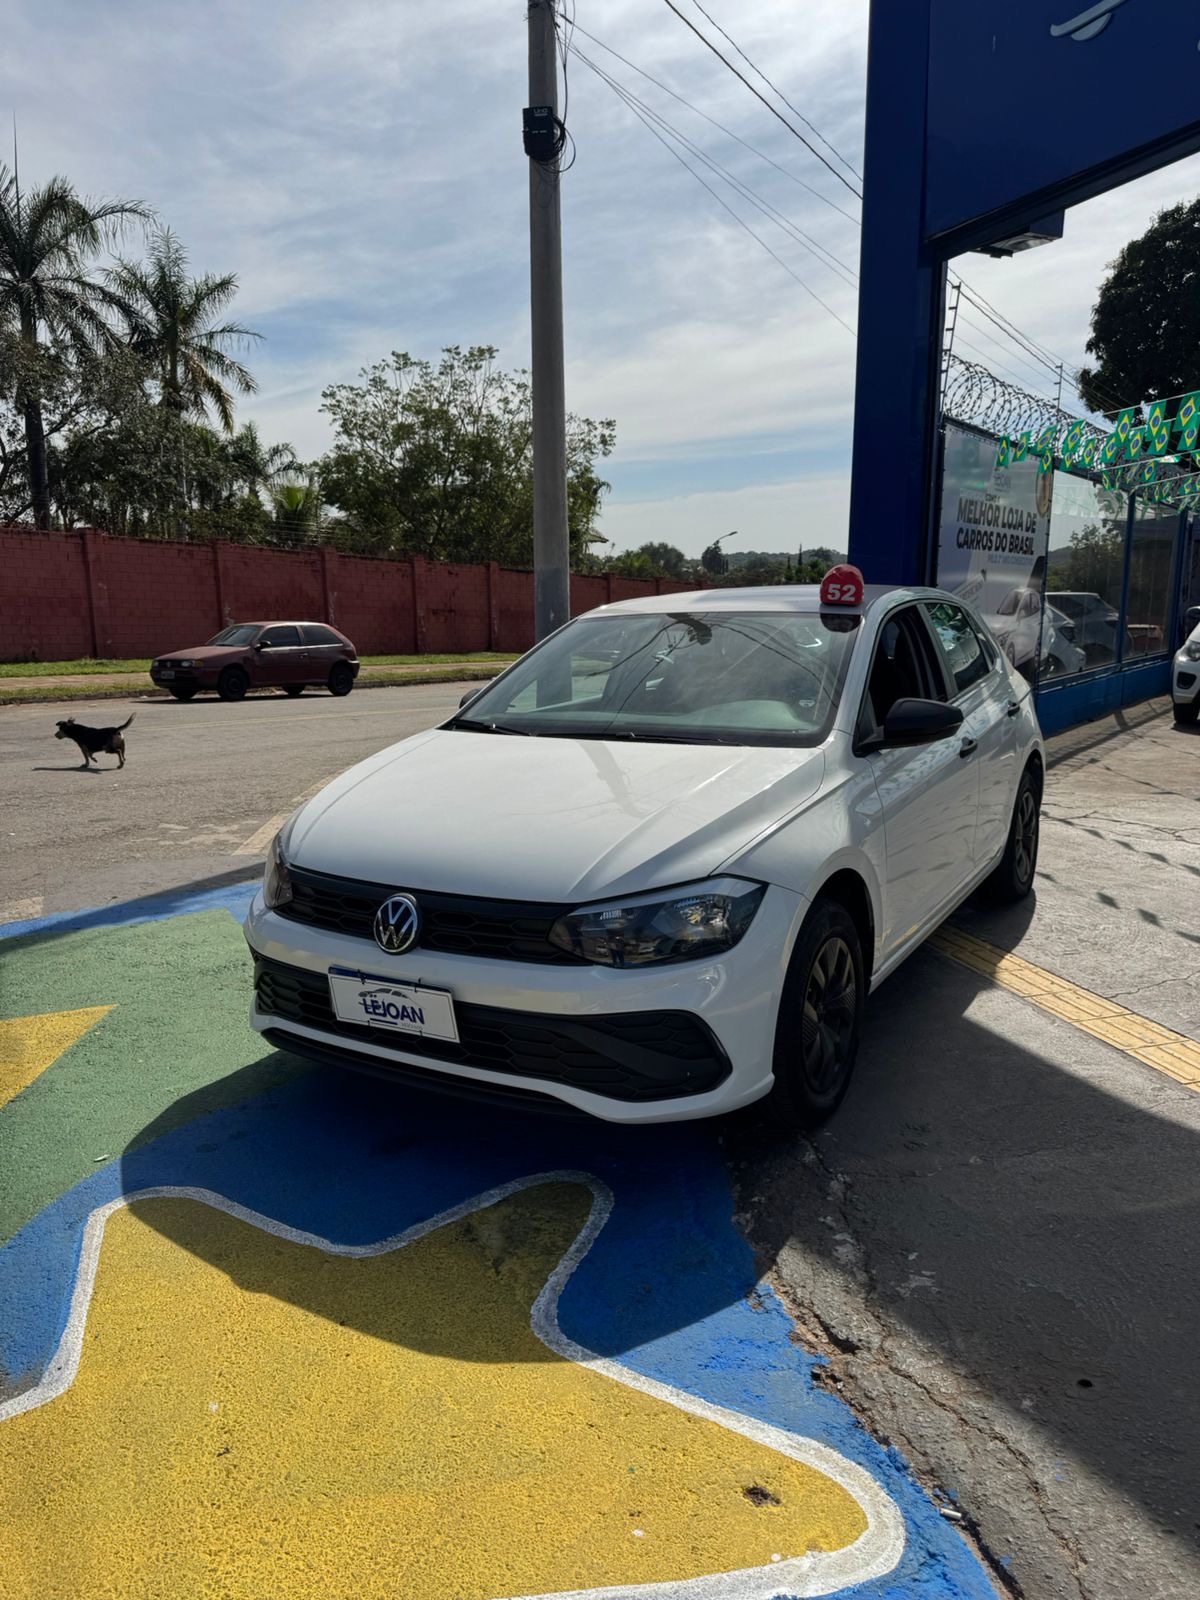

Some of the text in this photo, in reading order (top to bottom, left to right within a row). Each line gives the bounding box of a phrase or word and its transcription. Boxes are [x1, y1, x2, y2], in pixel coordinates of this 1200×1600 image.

[956, 498, 1000, 527] MELHOR
[1001, 507, 1023, 531] LOJA
[1025, 512, 1037, 533] DE
[956, 527, 1034, 555] CARROS DO BRASIL
[827, 583, 856, 601] 52
